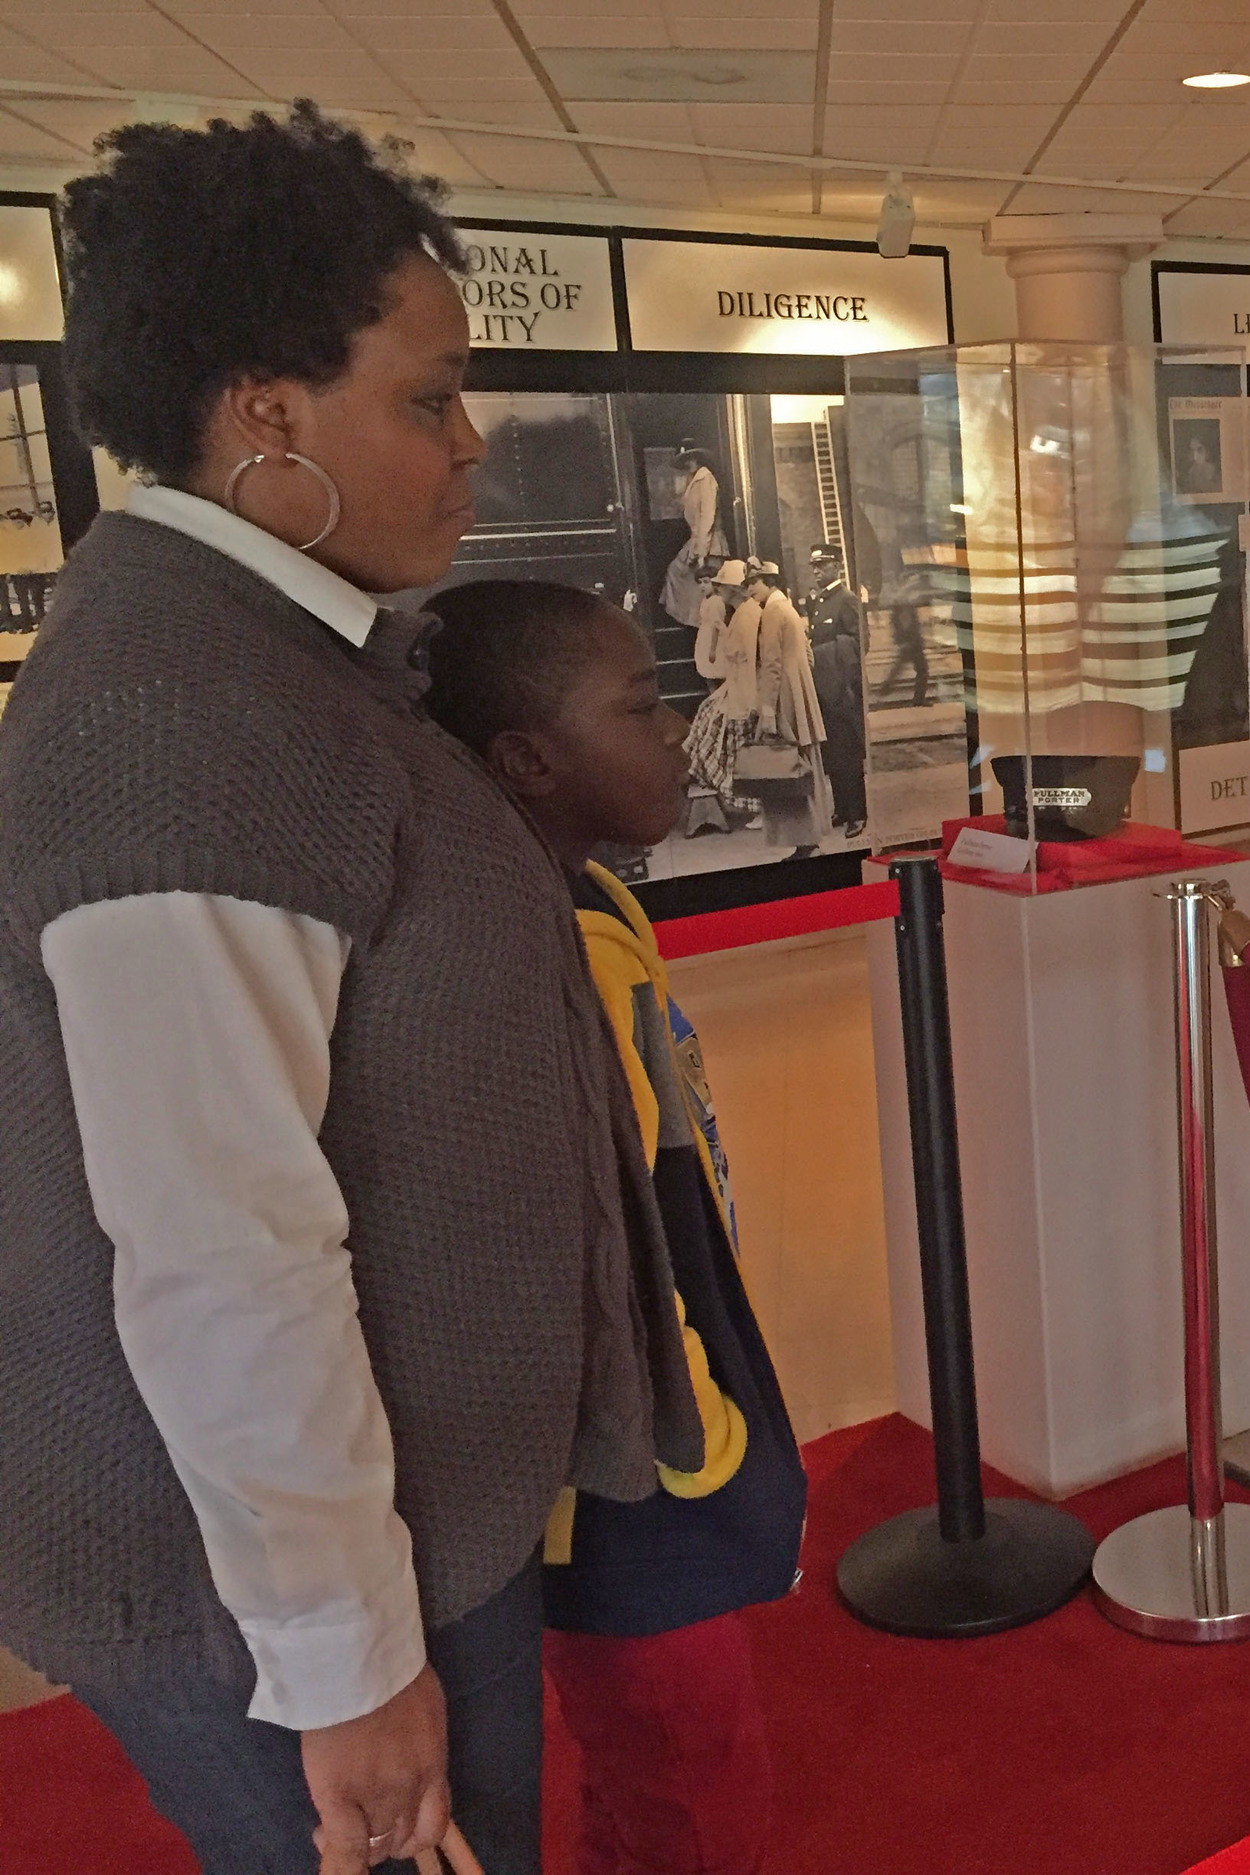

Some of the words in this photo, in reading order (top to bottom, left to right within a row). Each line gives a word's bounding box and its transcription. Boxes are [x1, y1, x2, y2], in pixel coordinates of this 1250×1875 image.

[540, 283, 582, 311] OF
[717, 290, 869, 322] DILIGENCE
[1033, 790, 1085, 798] PULLMAN
